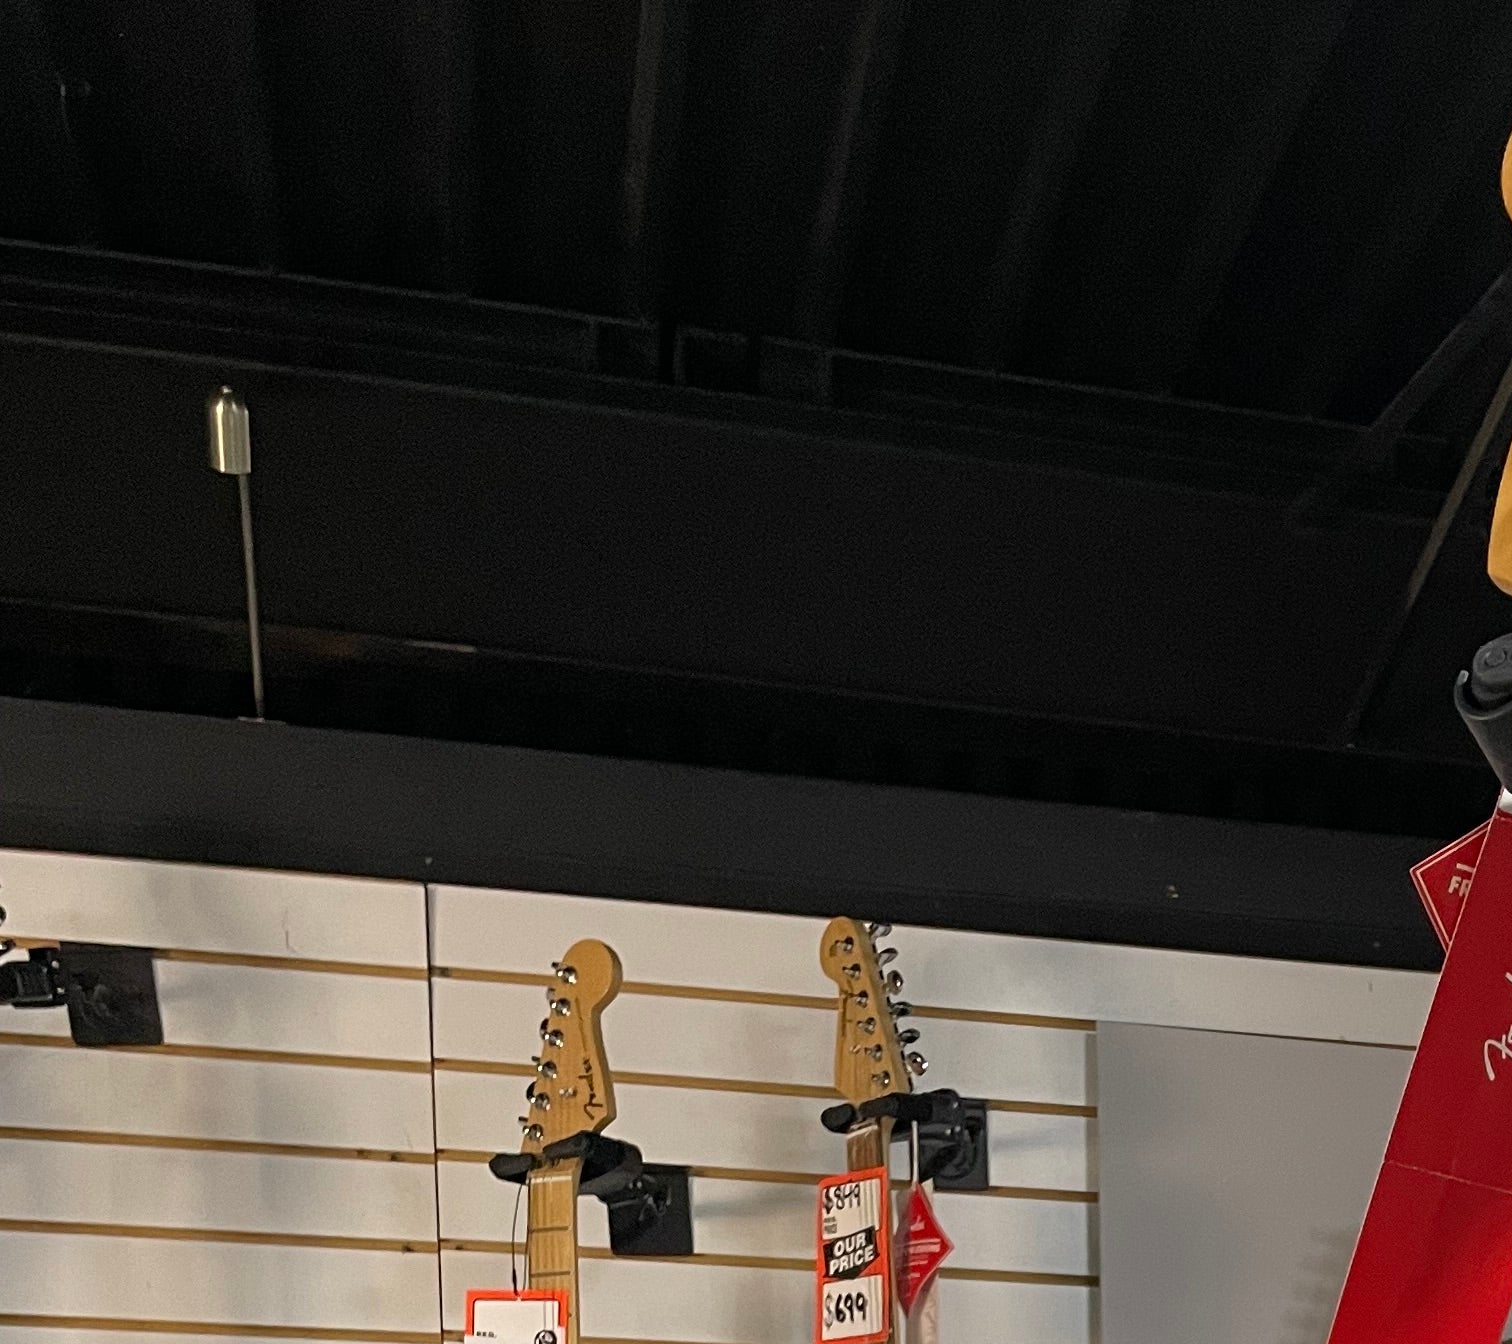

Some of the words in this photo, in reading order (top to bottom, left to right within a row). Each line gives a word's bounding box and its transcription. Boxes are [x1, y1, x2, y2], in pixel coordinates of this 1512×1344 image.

[829, 1244, 876, 1276] PRICE
[833, 1231, 867, 1257] OUR
[824, 1292, 868, 1331] $699
